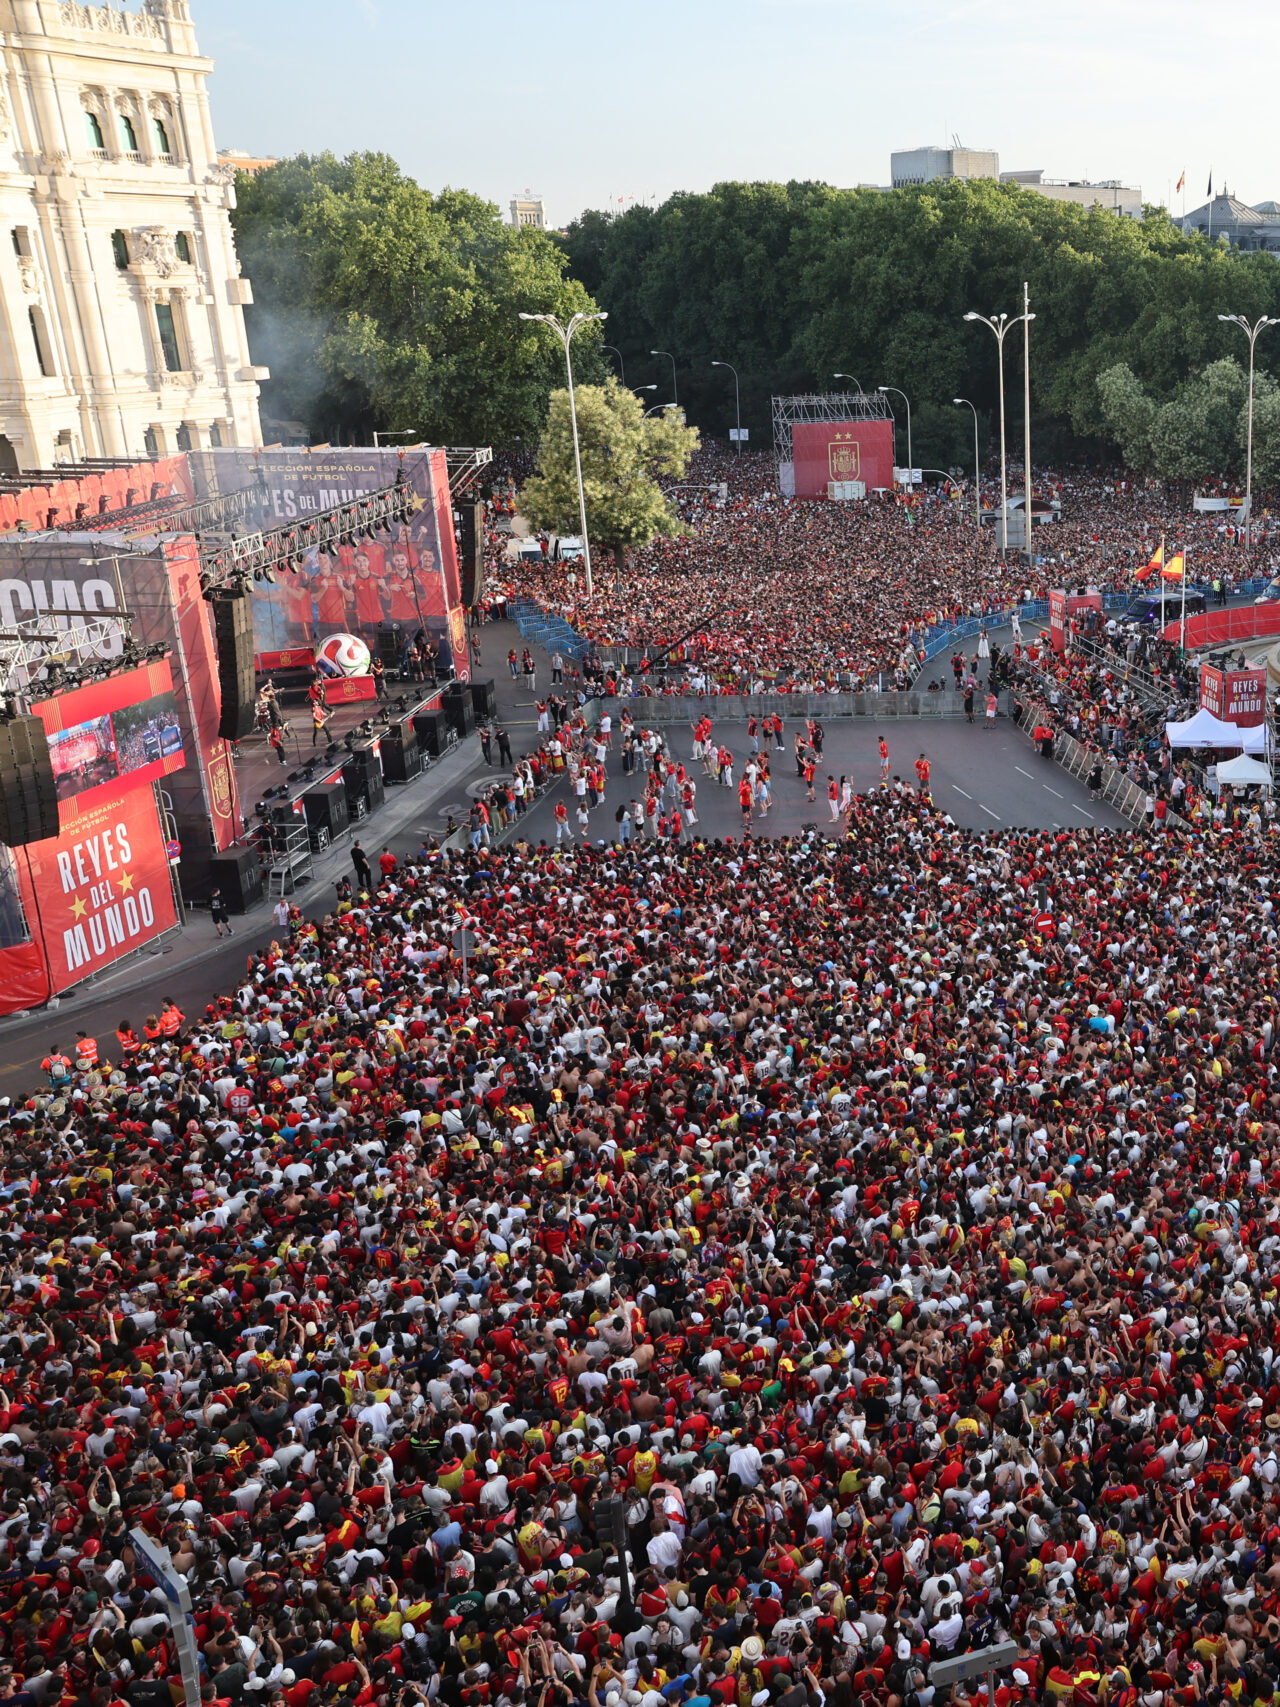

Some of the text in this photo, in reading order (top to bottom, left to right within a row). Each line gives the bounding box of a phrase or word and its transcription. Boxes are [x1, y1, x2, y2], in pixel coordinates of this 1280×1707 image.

[316, 463, 376, 473] ESPAÑOLA
[302, 472, 347, 481] FÚTBOL
[300, 495, 318, 510] DEL
[1232, 679, 1258, 694] REYES
[1228, 699, 1261, 714] MUNDO
[59, 798, 125, 833] ECCIÓN ESPAÑOLA
[70, 815, 109, 836] DE FÚTBOL
[56, 823, 132, 894] REYES
[90, 879, 115, 909] DEL
[62, 887, 154, 972] MUNDO
[230, 1095, 249, 1107] 88
[910, 1210, 916, 1222] 2
[555, 1387, 567, 1403] 12
[705, 1481, 711, 1493] 9
[981, 1628, 989, 1642] 6
